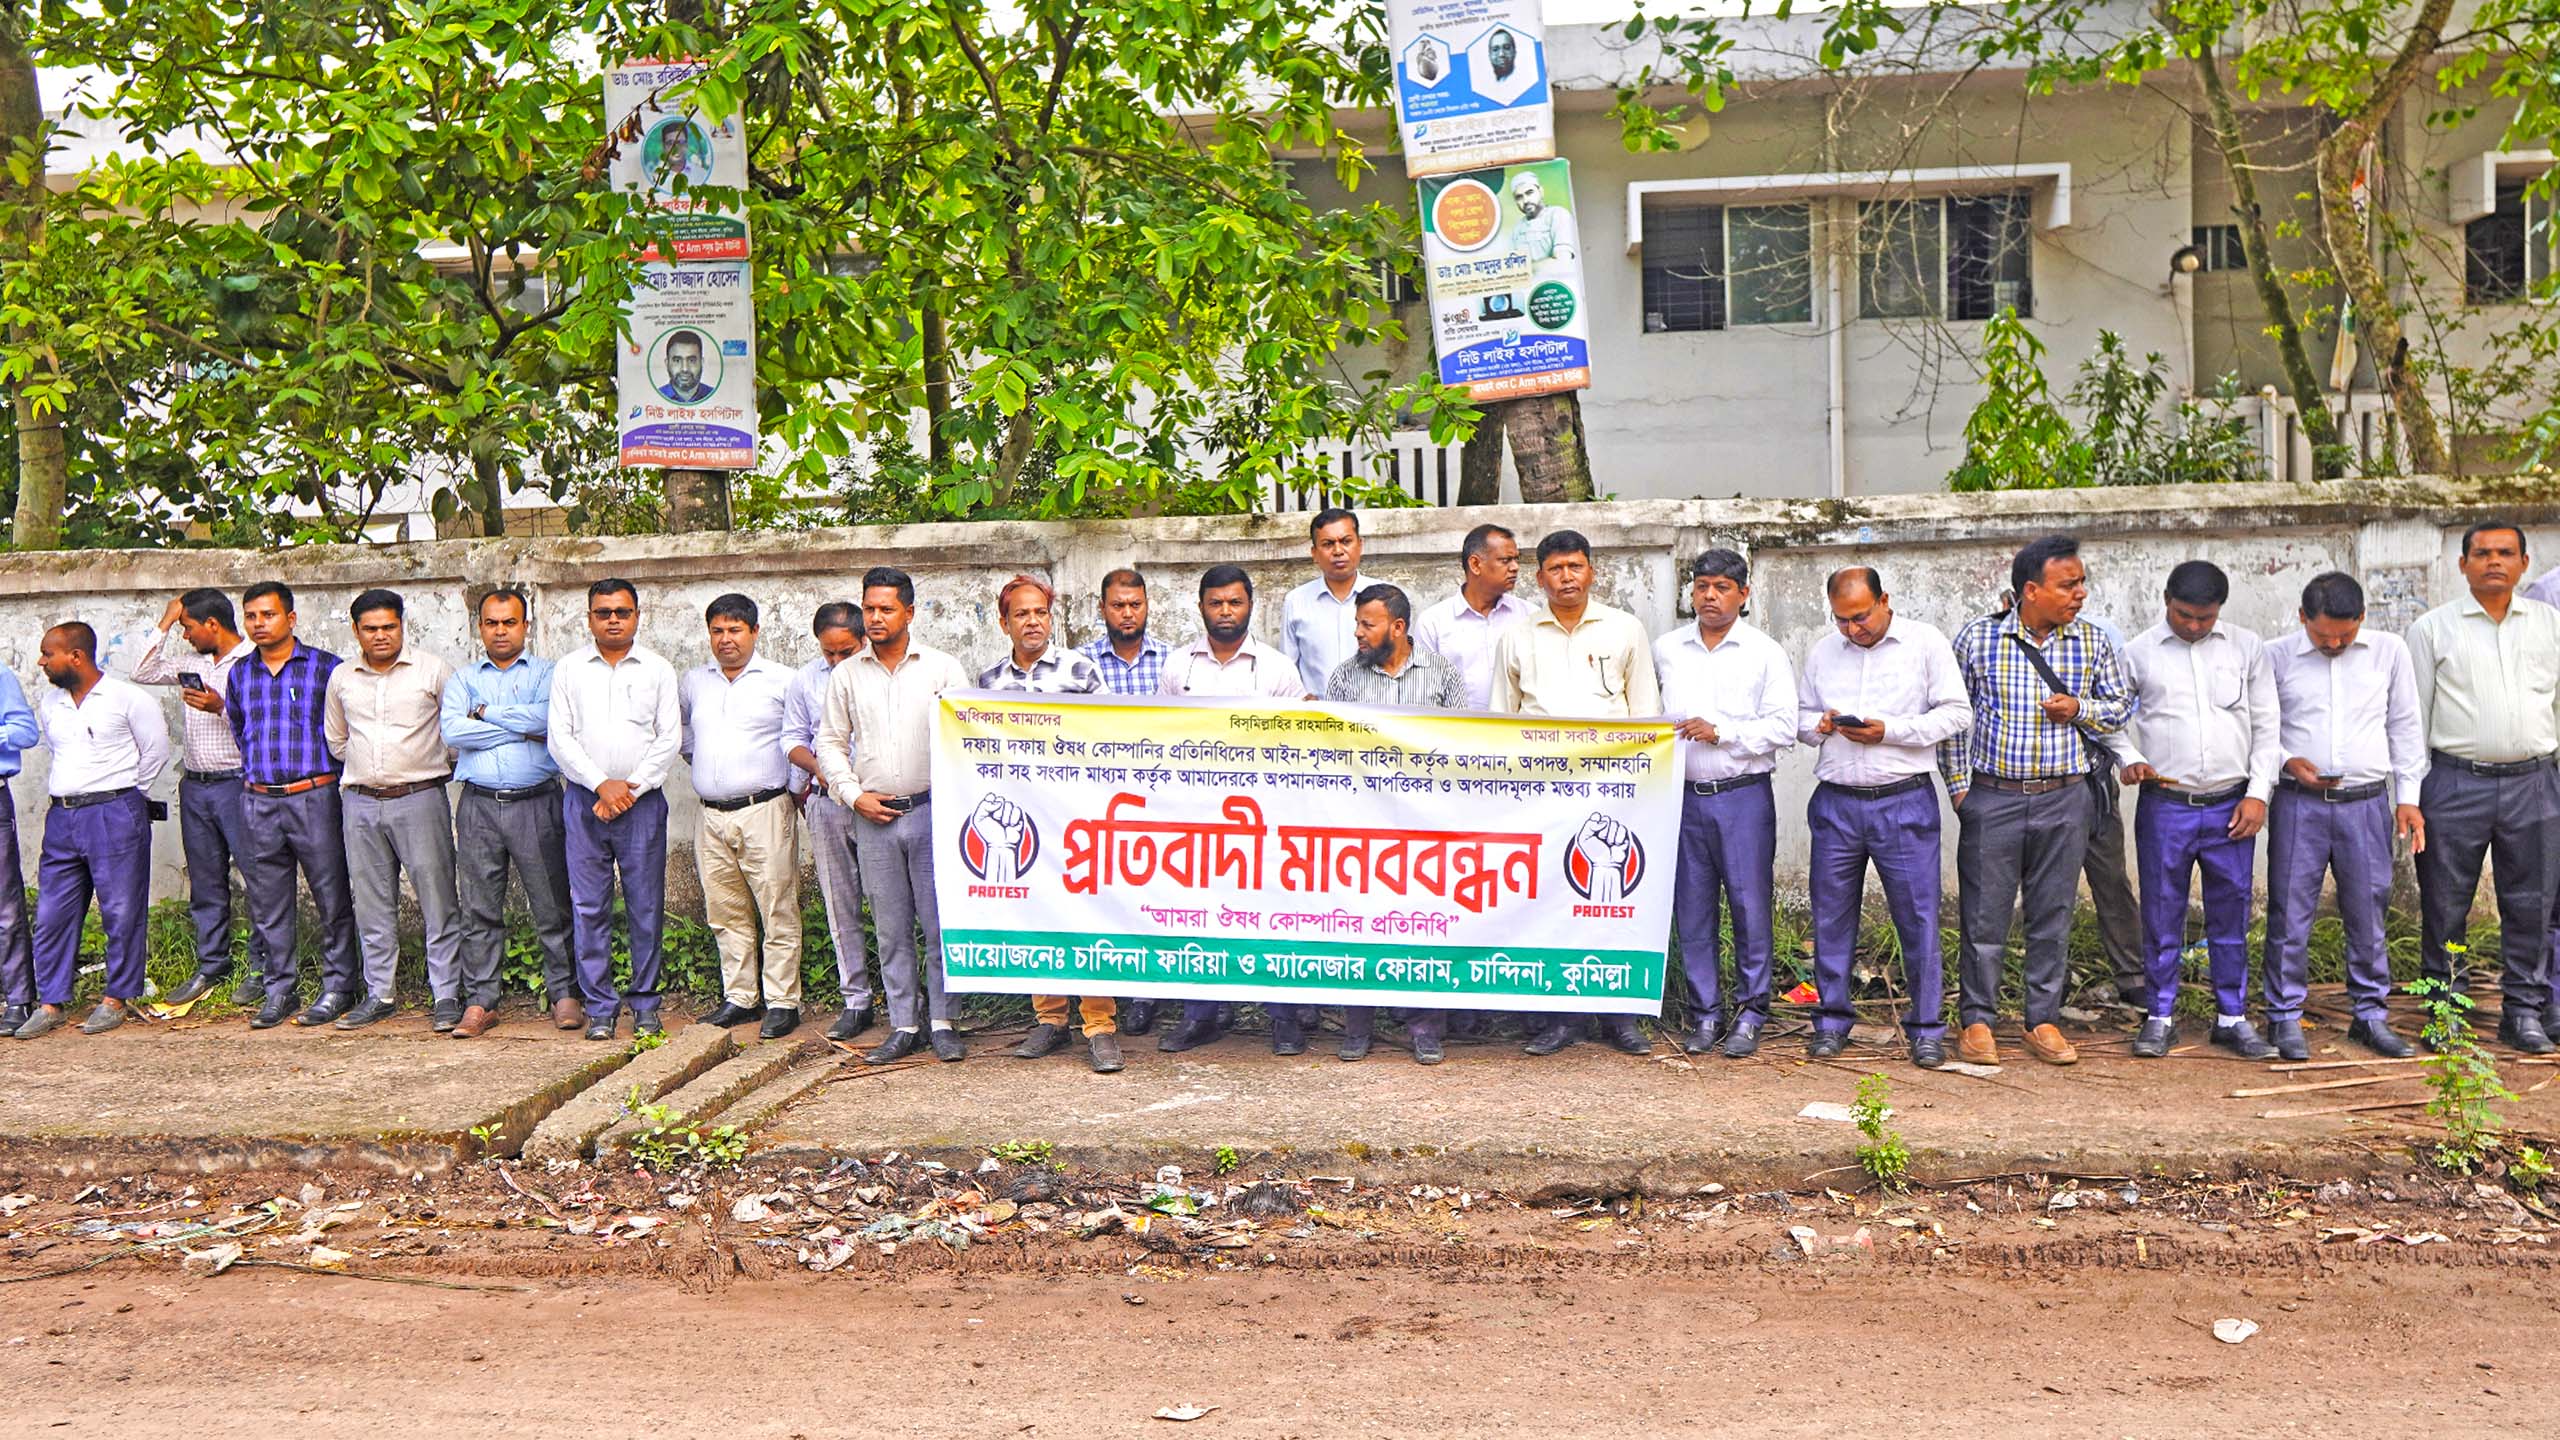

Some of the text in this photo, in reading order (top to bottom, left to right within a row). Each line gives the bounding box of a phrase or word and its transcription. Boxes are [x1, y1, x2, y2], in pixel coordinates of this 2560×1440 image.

[611, 72, 629, 86] ডাঃ
[633, 72, 654, 85] মোঃ
[707, 270, 741, 288] হোসেন
[1458, 350, 1481, 368] নিউ
[1484, 347, 1516, 363] লাইফ
[1519, 340, 1569, 359] হসপিটাল
[645, 405, 744, 421] নিউ লাইফ হসপিটাল
[955, 707, 1062, 726] অধিকার আমাদের
[1296, 717, 1344, 733] রাহমানির
[1520, 728, 1658, 745] আমরা সবাই একসাথে
[962, 736, 1001, 755] দফায়
[1007, 738, 1046, 756] দফায়
[1052, 735, 1087, 756] ঔষধ
[1092, 738, 1165, 760] কোম্পানির
[1169, 739, 1256, 763] প্রতিনিধিদের
[1261, 743, 1354, 770] আইন-শৃঙ্খলা
[1358, 745, 1404, 769] বাহিনী
[1409, 748, 1449, 775] কর্তৃক
[1455, 754, 1513, 775] অপমান,
[1580, 752, 1652, 774] সম্মানহানি
[976, 762, 1637, 801] করা সহ সংবাদ মাধ্যম কর্তৃক আমাদেরকে অপমানজনক, আপত্তিকর ও অপবাদমূলক মন্তব্য করায়
[1062, 792, 1543, 913] প্রতিবাদী মানববন্ধন
[968, 885, 1030, 899] PROTEST
[1141, 903, 1460, 938] “আমরা ঔষধ কোম্পানির প্রতিনিধি”
[1572, 904, 1635, 919] PROTEST
[946, 940, 1066, 970] আয়োজনেঃ
[1072, 938, 1149, 974] চান্দিনা
[1155, 942, 1229, 976] ফারিয়া
[1237, 954, 1257, 975] ও
[1264, 951, 1365, 983] ম্যানেজার
[1375, 956, 1460, 989] ফোরাম,
[1468, 953, 1553, 993] চান্দিনা,
[1559, 954, 1632, 996] কুমিল্লা
